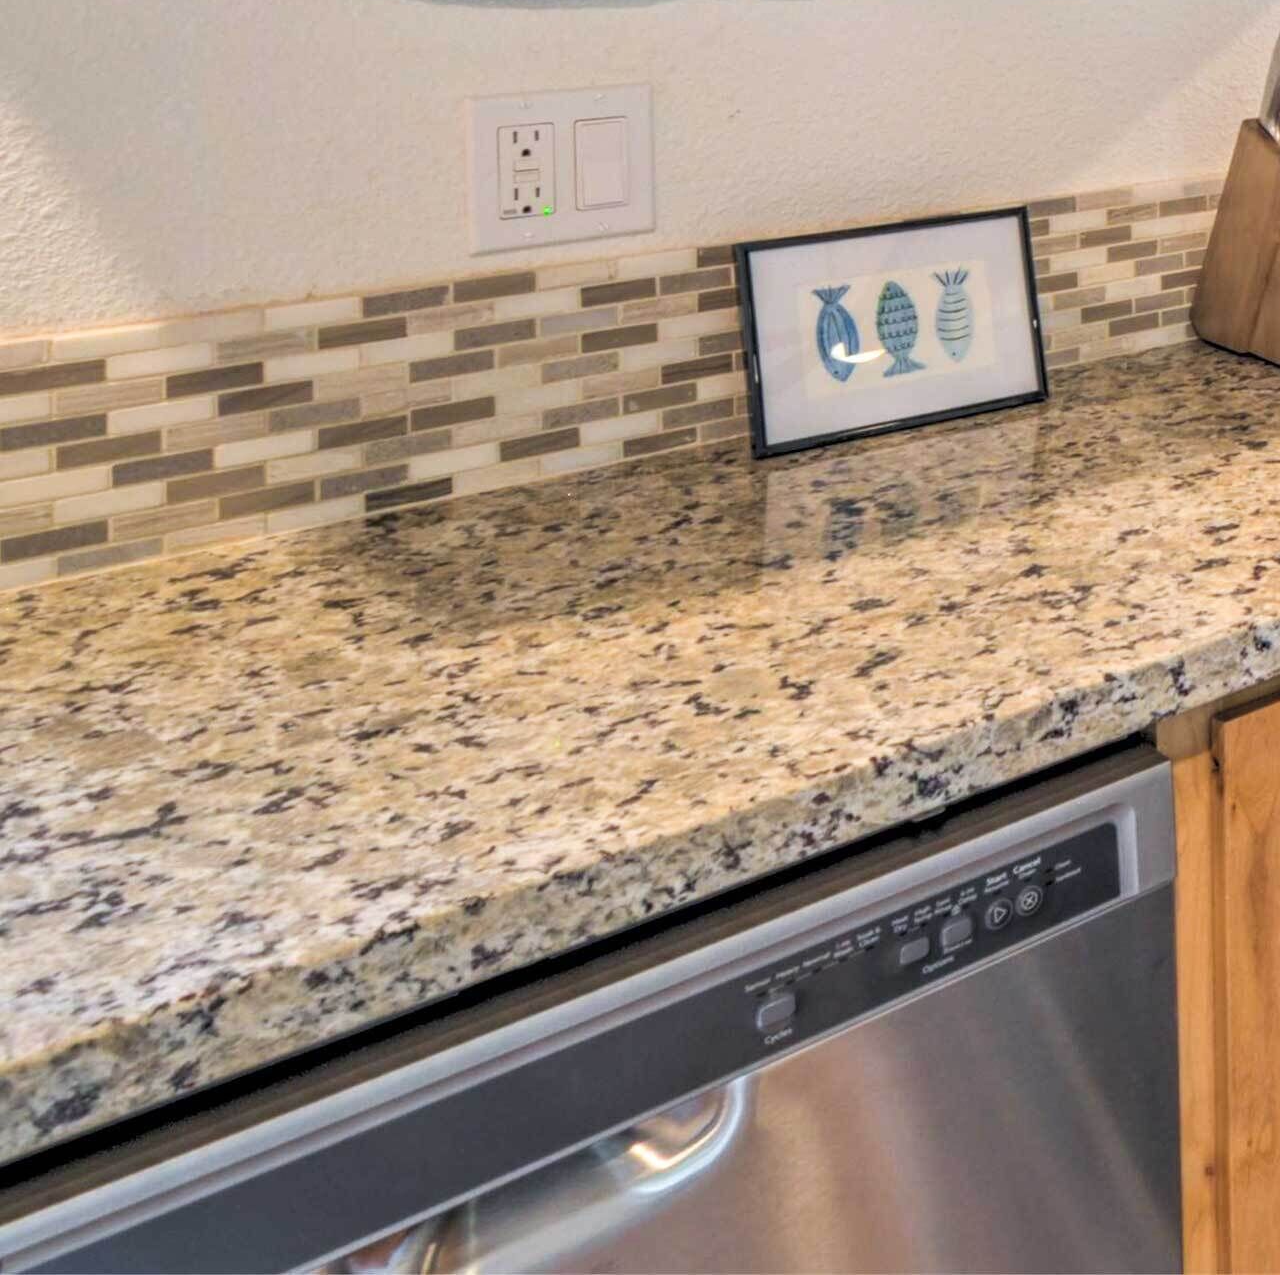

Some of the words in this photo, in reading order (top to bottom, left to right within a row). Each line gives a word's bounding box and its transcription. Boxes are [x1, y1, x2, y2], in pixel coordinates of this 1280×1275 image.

[1013, 857, 1042, 875] Cancel
[986, 873, 1008, 886] Start
[764, 1028, 793, 1045] Cycles
